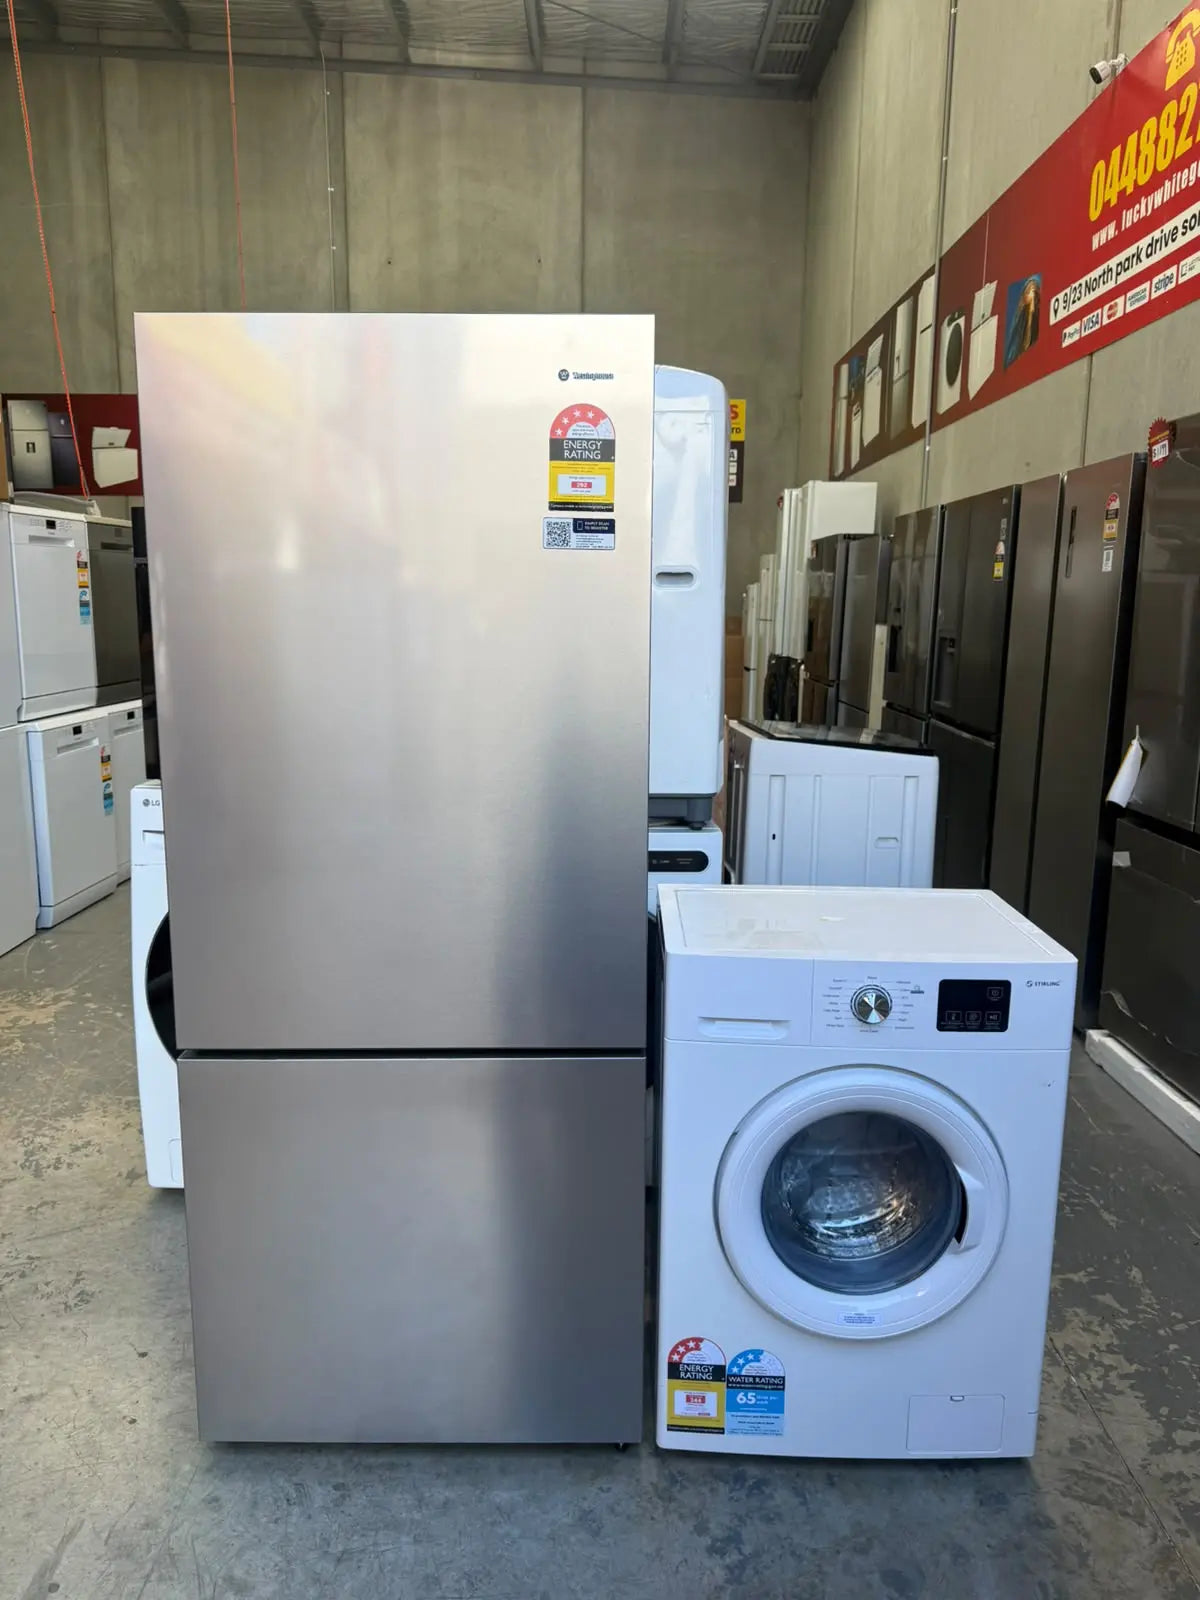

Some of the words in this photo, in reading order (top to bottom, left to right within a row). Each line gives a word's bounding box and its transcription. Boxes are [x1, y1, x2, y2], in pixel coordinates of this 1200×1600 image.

[1089, 80, 1200, 222] 044882
[1063, 283, 1082, 312] 9/23
[1084, 261, 1113, 299] North
[1115, 245, 1143, 284] park
[1145, 223, 1179, 259] drive
[1154, 271, 1175, 293] stripe
[1082, 311, 1100, 333] VISA
[563, 440, 602, 449] ENERGY
[564, 449, 601, 459] RATING
[680, 1364, 714, 1373] ENERGY
[680, 1371, 713, 1380] RATING
[728, 1376, 754, 1384] WATER
[755, 1377, 784, 1385] RATING
[736, 1392, 756, 1405] 65
